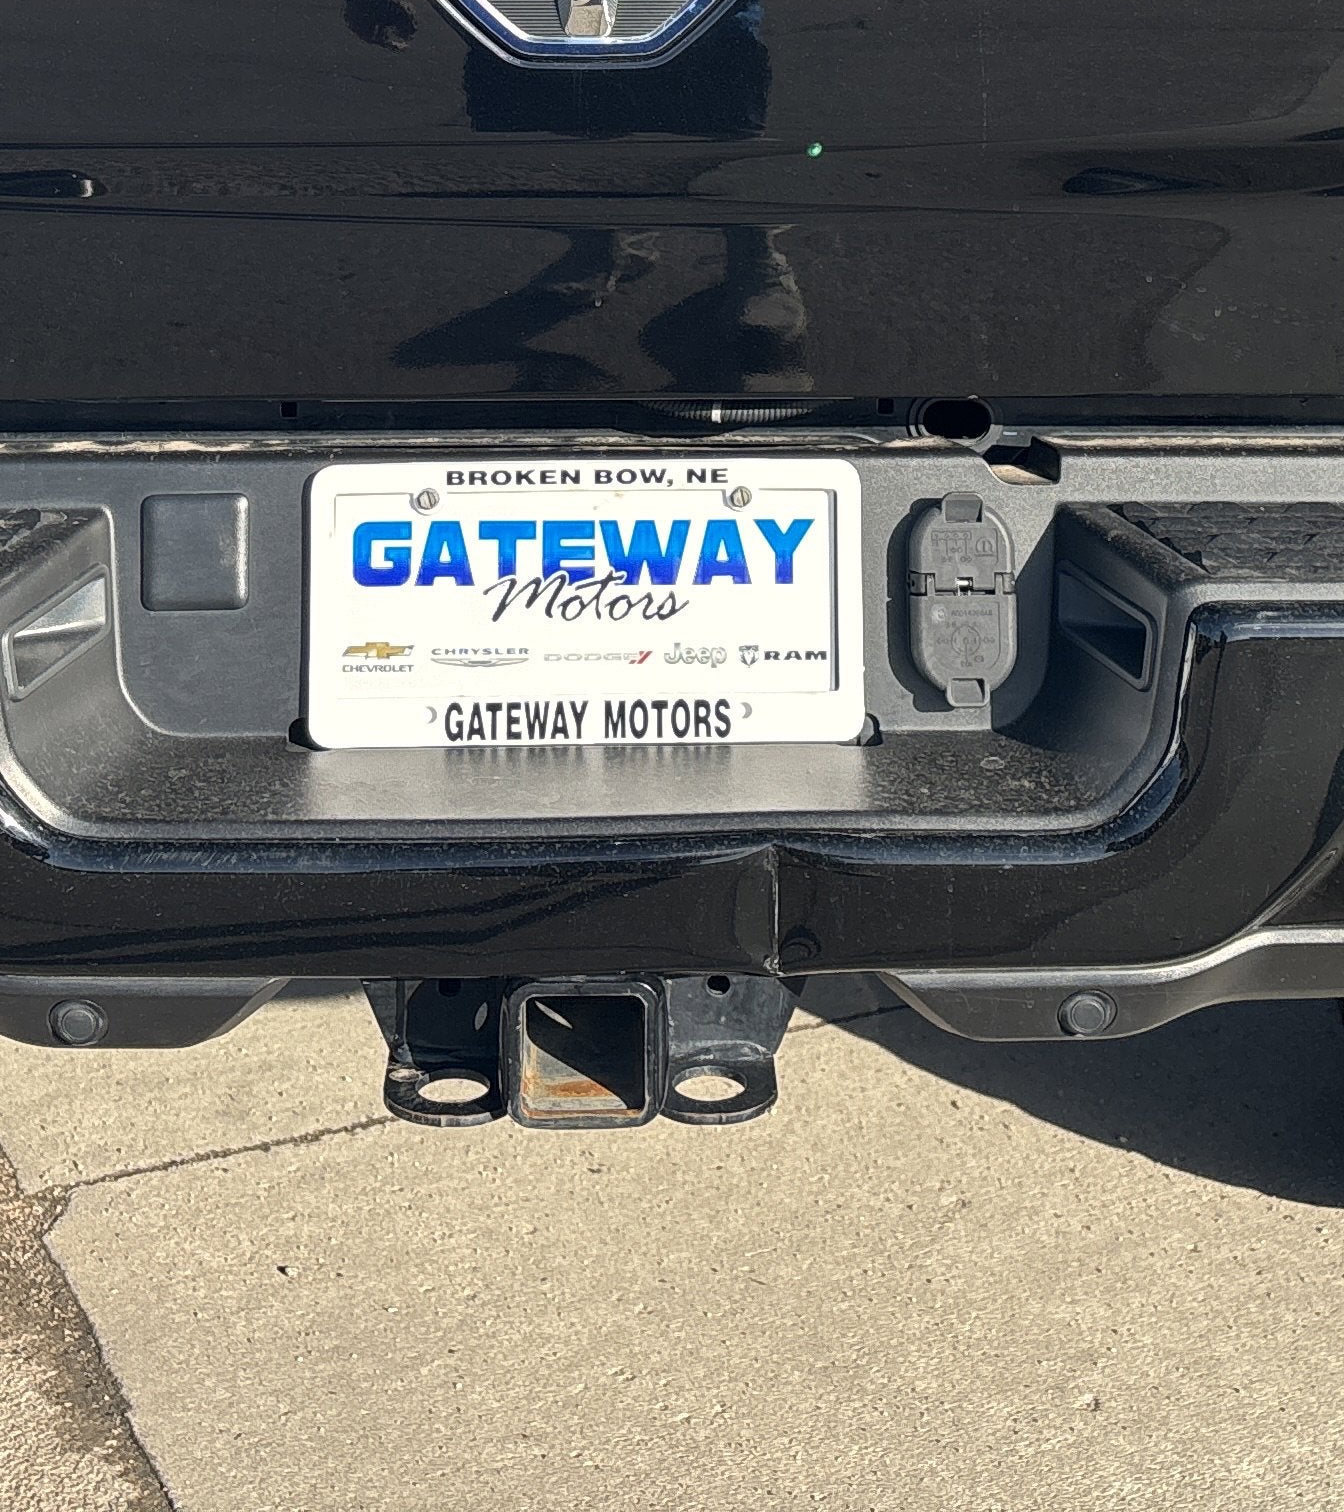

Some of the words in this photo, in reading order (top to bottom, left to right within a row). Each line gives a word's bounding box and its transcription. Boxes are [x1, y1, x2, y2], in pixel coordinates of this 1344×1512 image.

[445, 469, 582, 486] BROKEN
[593, 469, 675, 489] BOW,
[686, 468, 730, 485] NE
[352, 518, 815, 587] GATEWAY
[482, 569, 690, 623] Motors
[430, 647, 530, 656] CHRYSLER
[543, 653, 637, 662] DODGE
[663, 642, 728, 669] Jeep
[763, 650, 828, 661] RAM
[341, 664, 415, 673] CHEVROLET
[443, 699, 589, 742] GATEWAY
[603, 697, 733, 740] MOTORS
